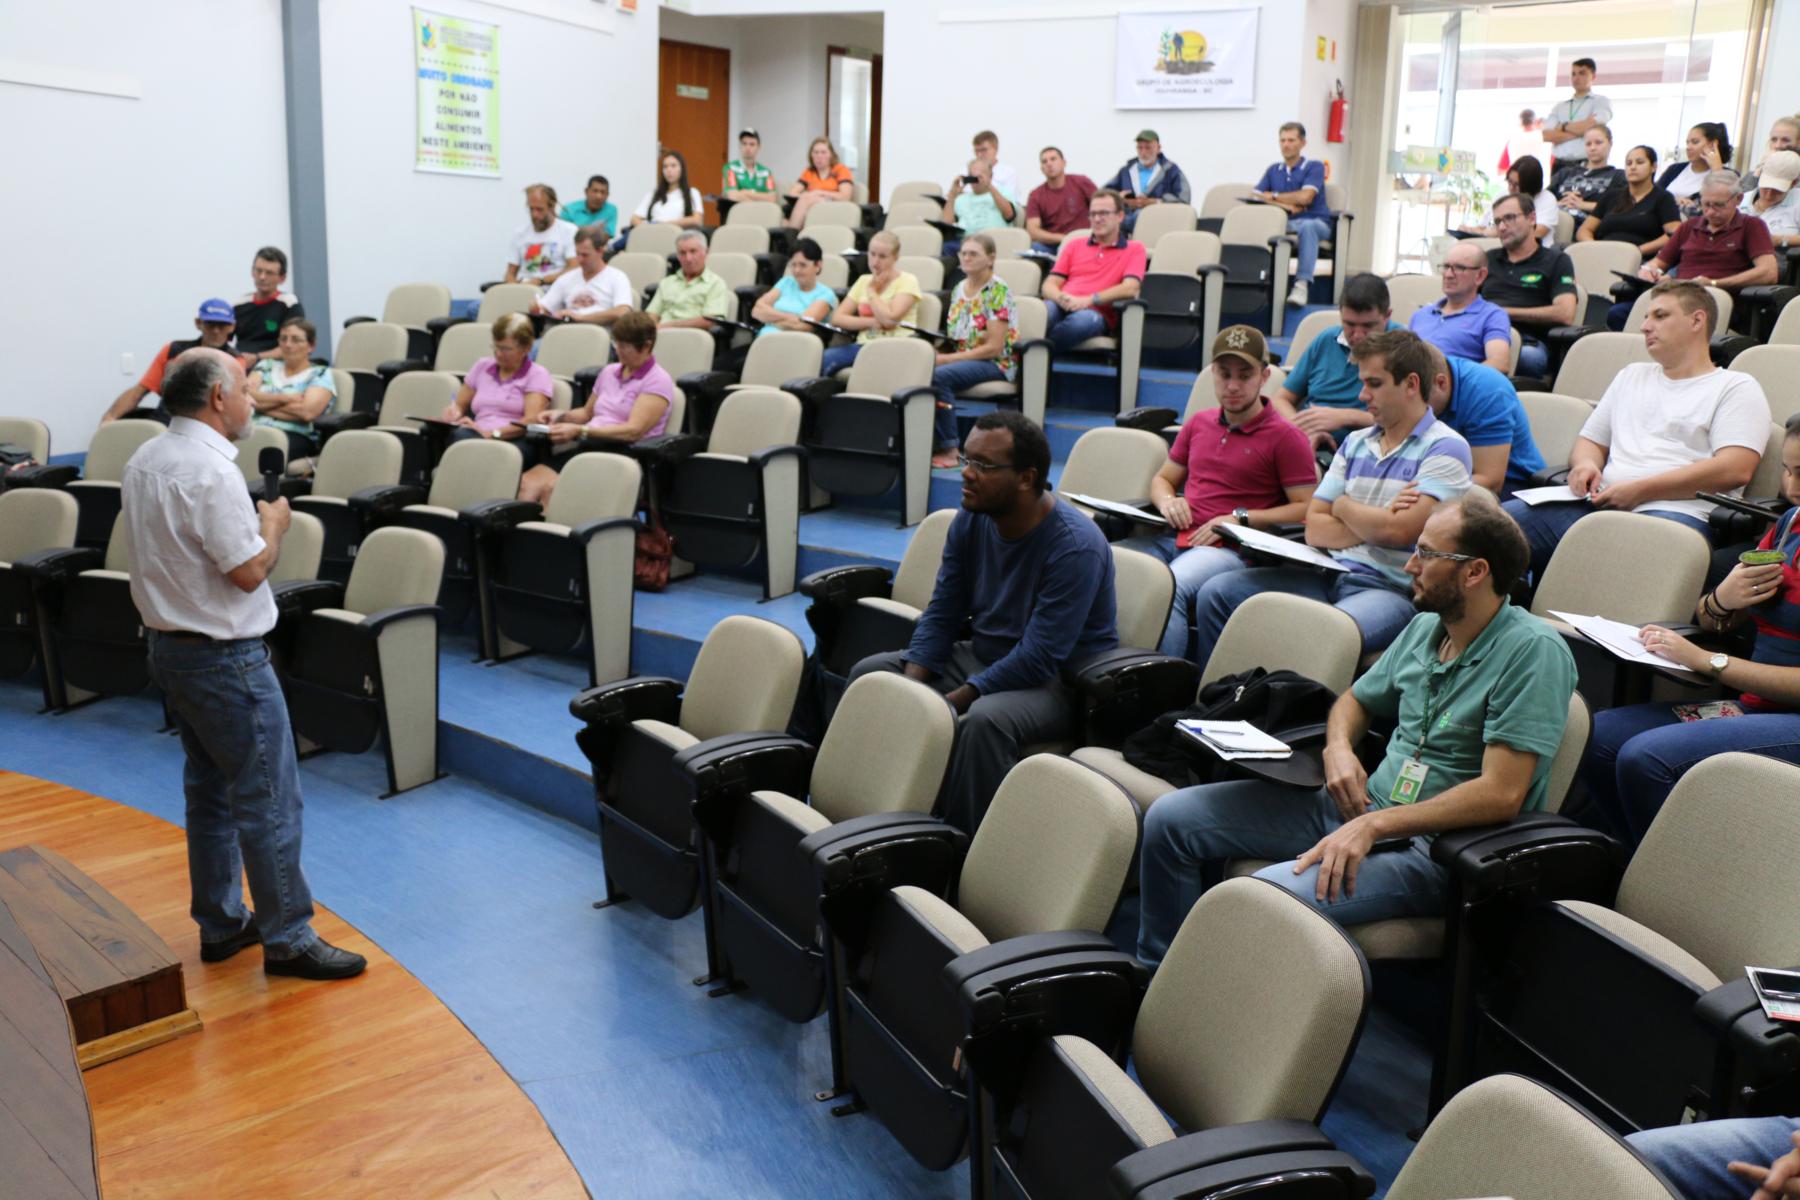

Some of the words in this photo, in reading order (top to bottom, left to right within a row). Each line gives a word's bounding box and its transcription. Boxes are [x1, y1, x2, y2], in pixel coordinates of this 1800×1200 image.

[438, 88, 456, 100] POR
[436, 105, 480, 119] CONSUMIR
[434, 122, 482, 135] ALIMENTOS
